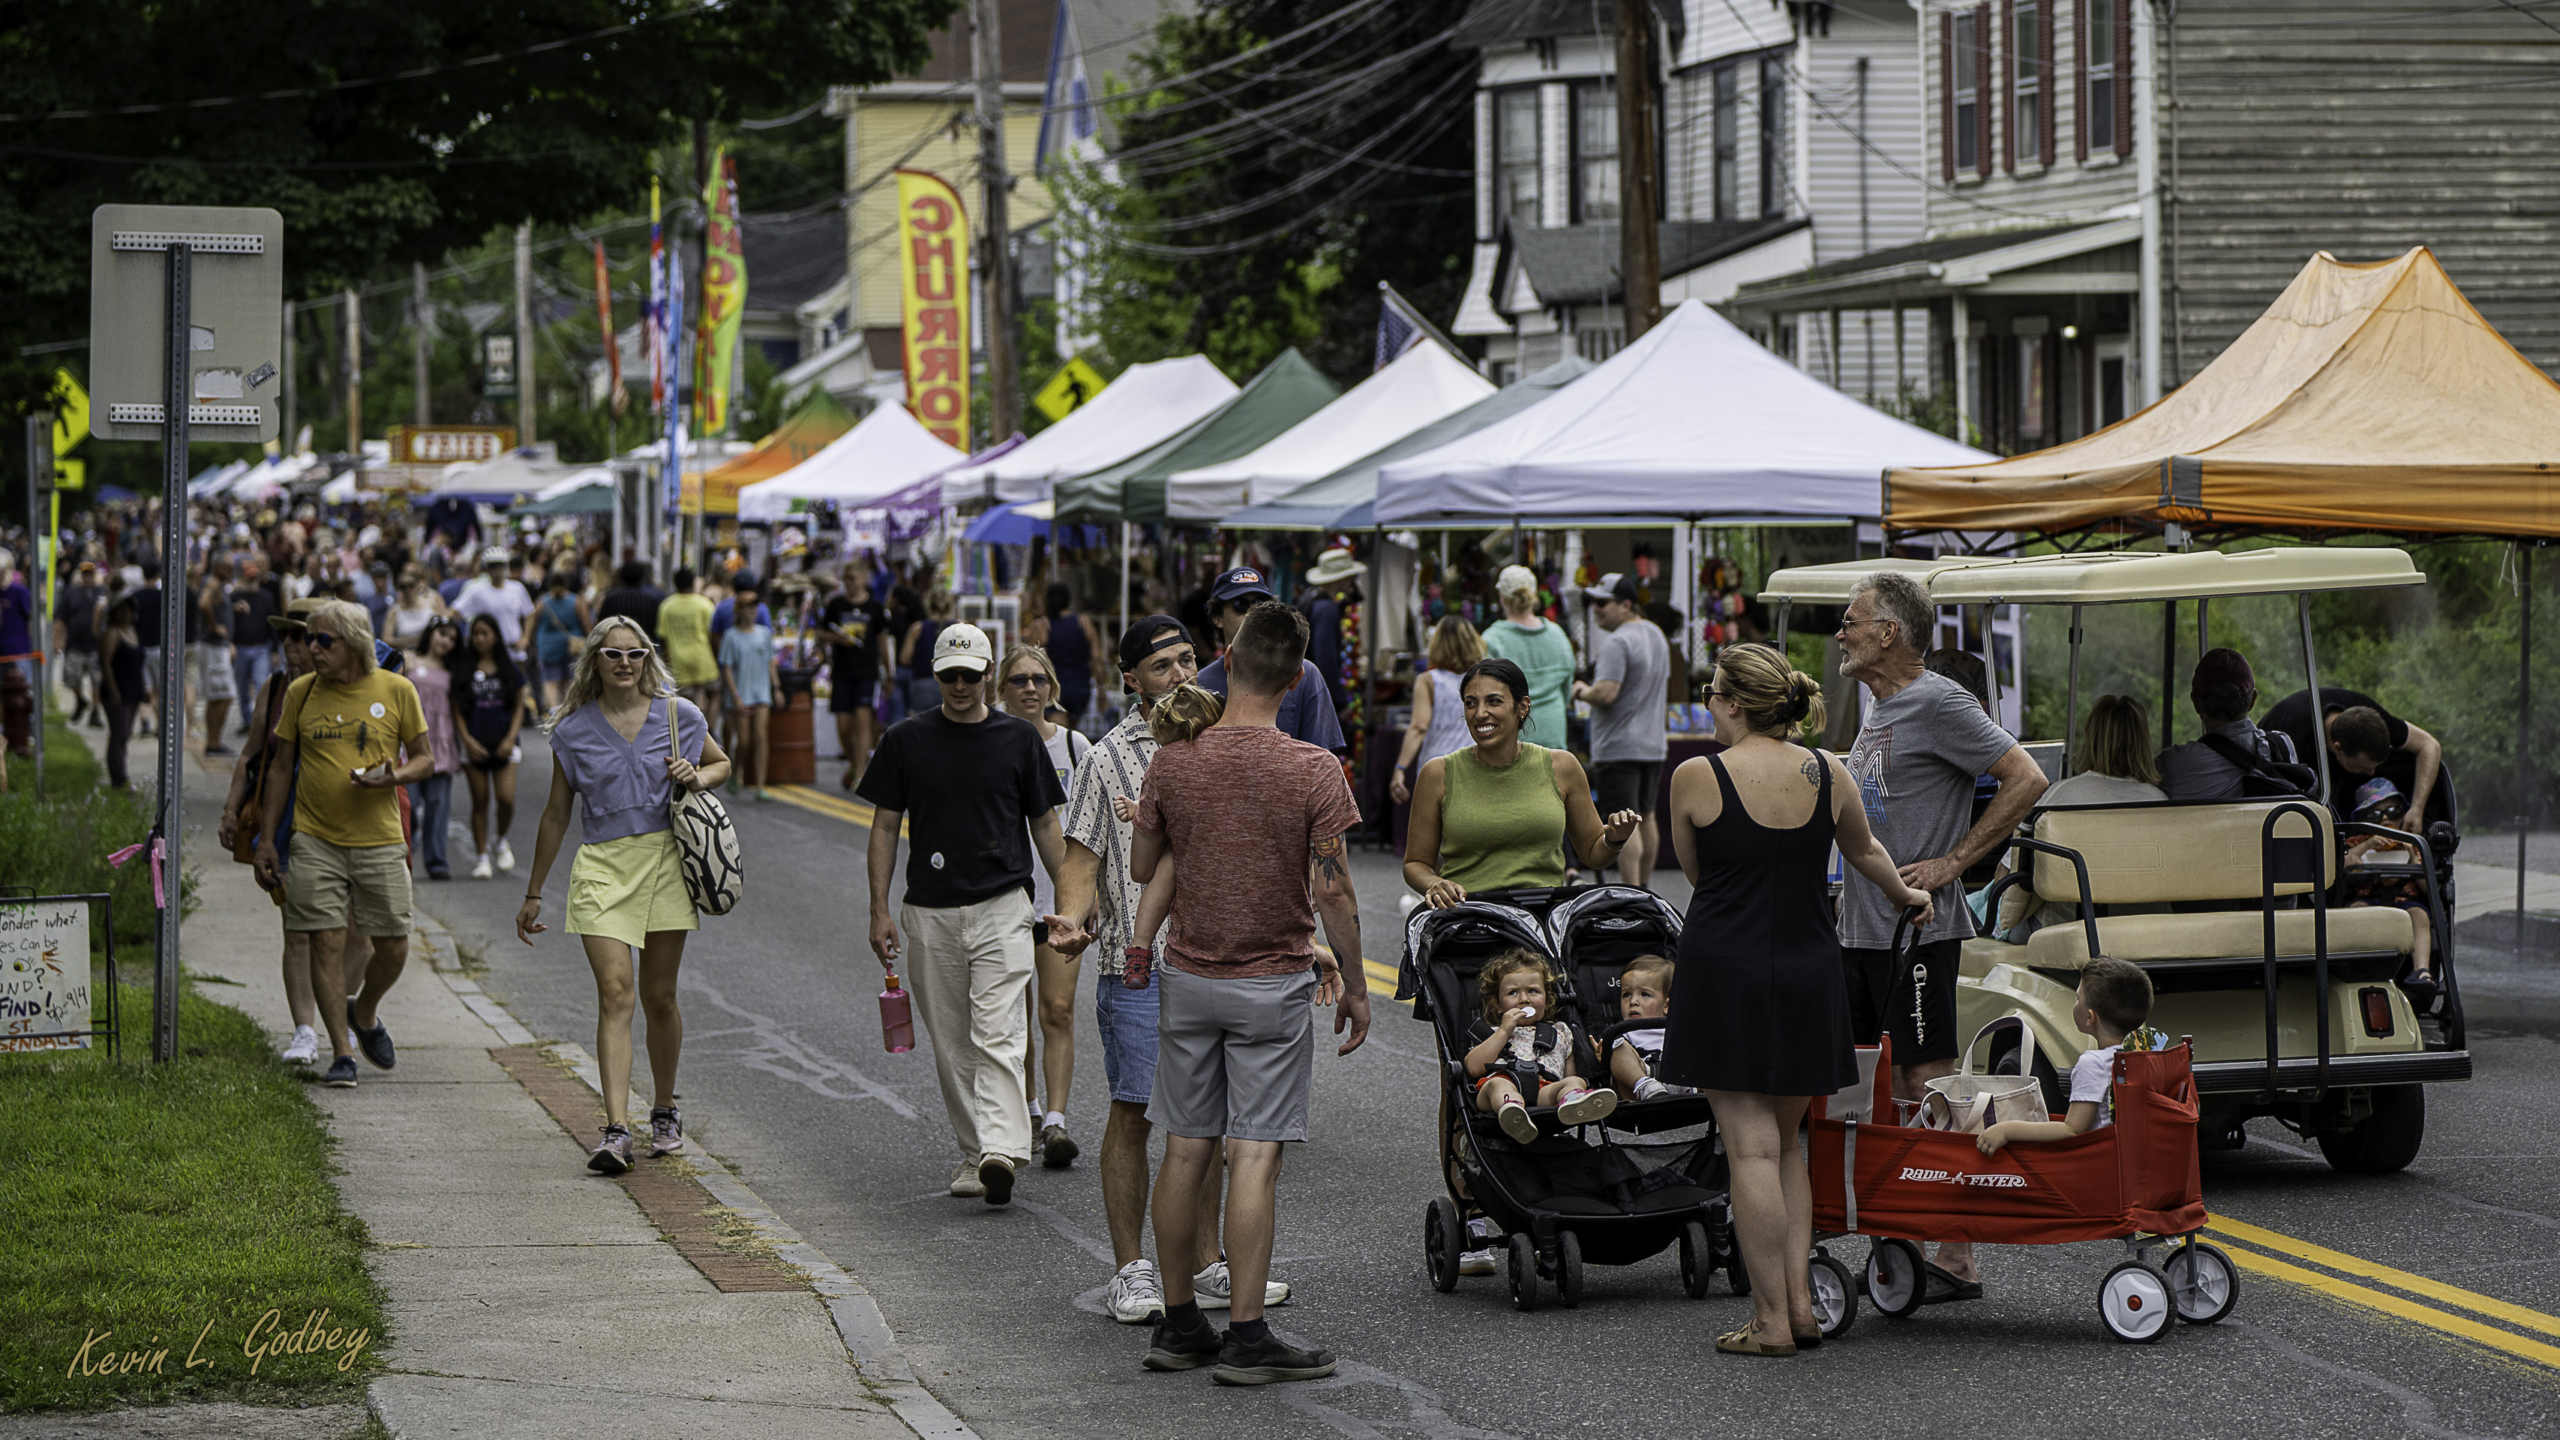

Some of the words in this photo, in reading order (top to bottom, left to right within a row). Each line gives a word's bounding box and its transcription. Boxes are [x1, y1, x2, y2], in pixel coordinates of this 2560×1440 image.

[423, 433, 493, 459] FRIES
[0, 914, 39, 934] onder
[45, 908, 78, 928] what
[44, 933, 59, 949] be
[1911, 963, 1927, 1046] Champion
[1899, 1167, 1950, 1181] RADIO
